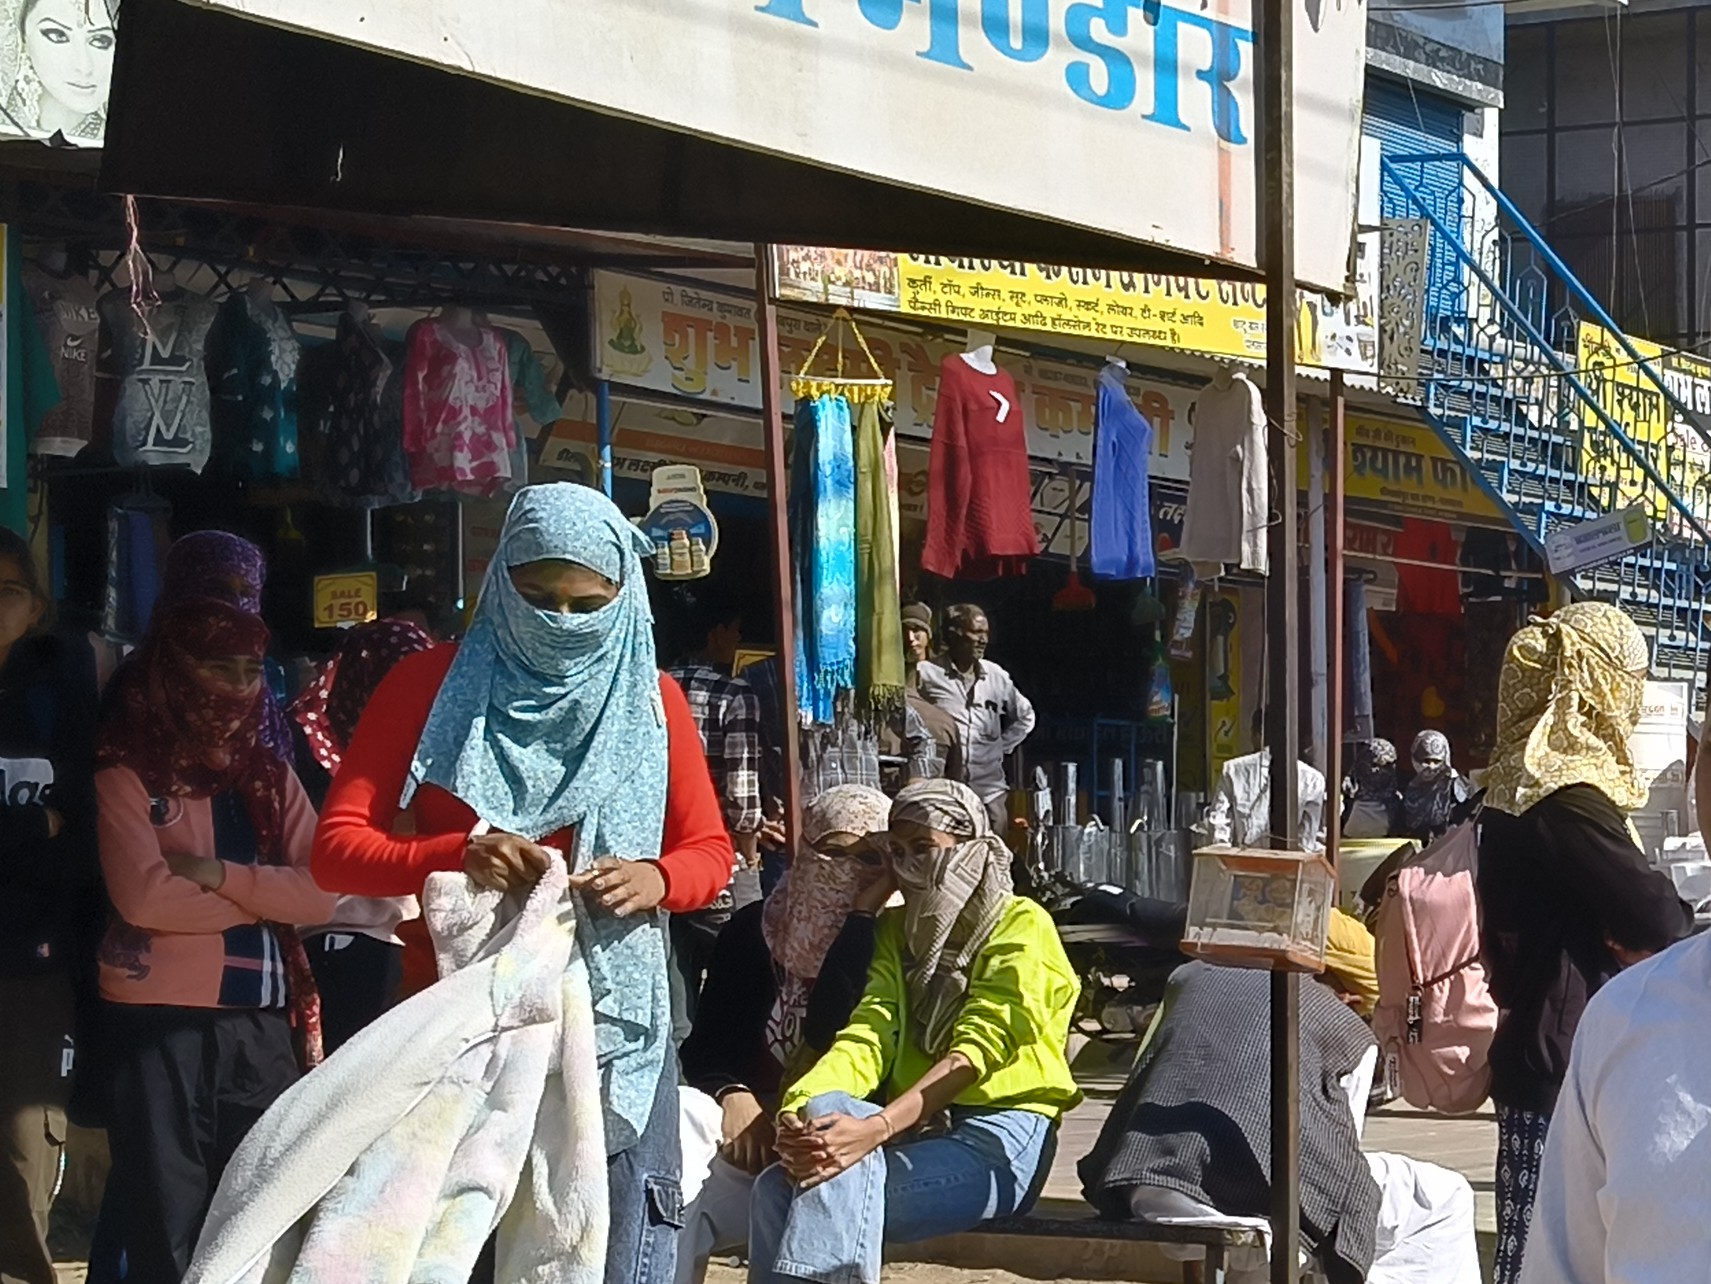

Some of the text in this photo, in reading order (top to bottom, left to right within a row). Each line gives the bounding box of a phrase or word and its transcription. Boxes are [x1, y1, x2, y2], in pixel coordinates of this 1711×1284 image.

[858, 0, 1258, 145] ण्डार
[940, 278, 965, 298] टॉप,
[1179, 311, 1205, 327] आदि
[1019, 310, 1048, 326] आदि
[1109, 324, 1125, 338] पर
[60, 346, 87, 362] NIKE
[661, 310, 757, 397] शुभ
[1351, 442, 1425, 487] श्याम
[322, 600, 368, 621] 150
[330, 588, 364, 600] SALE
